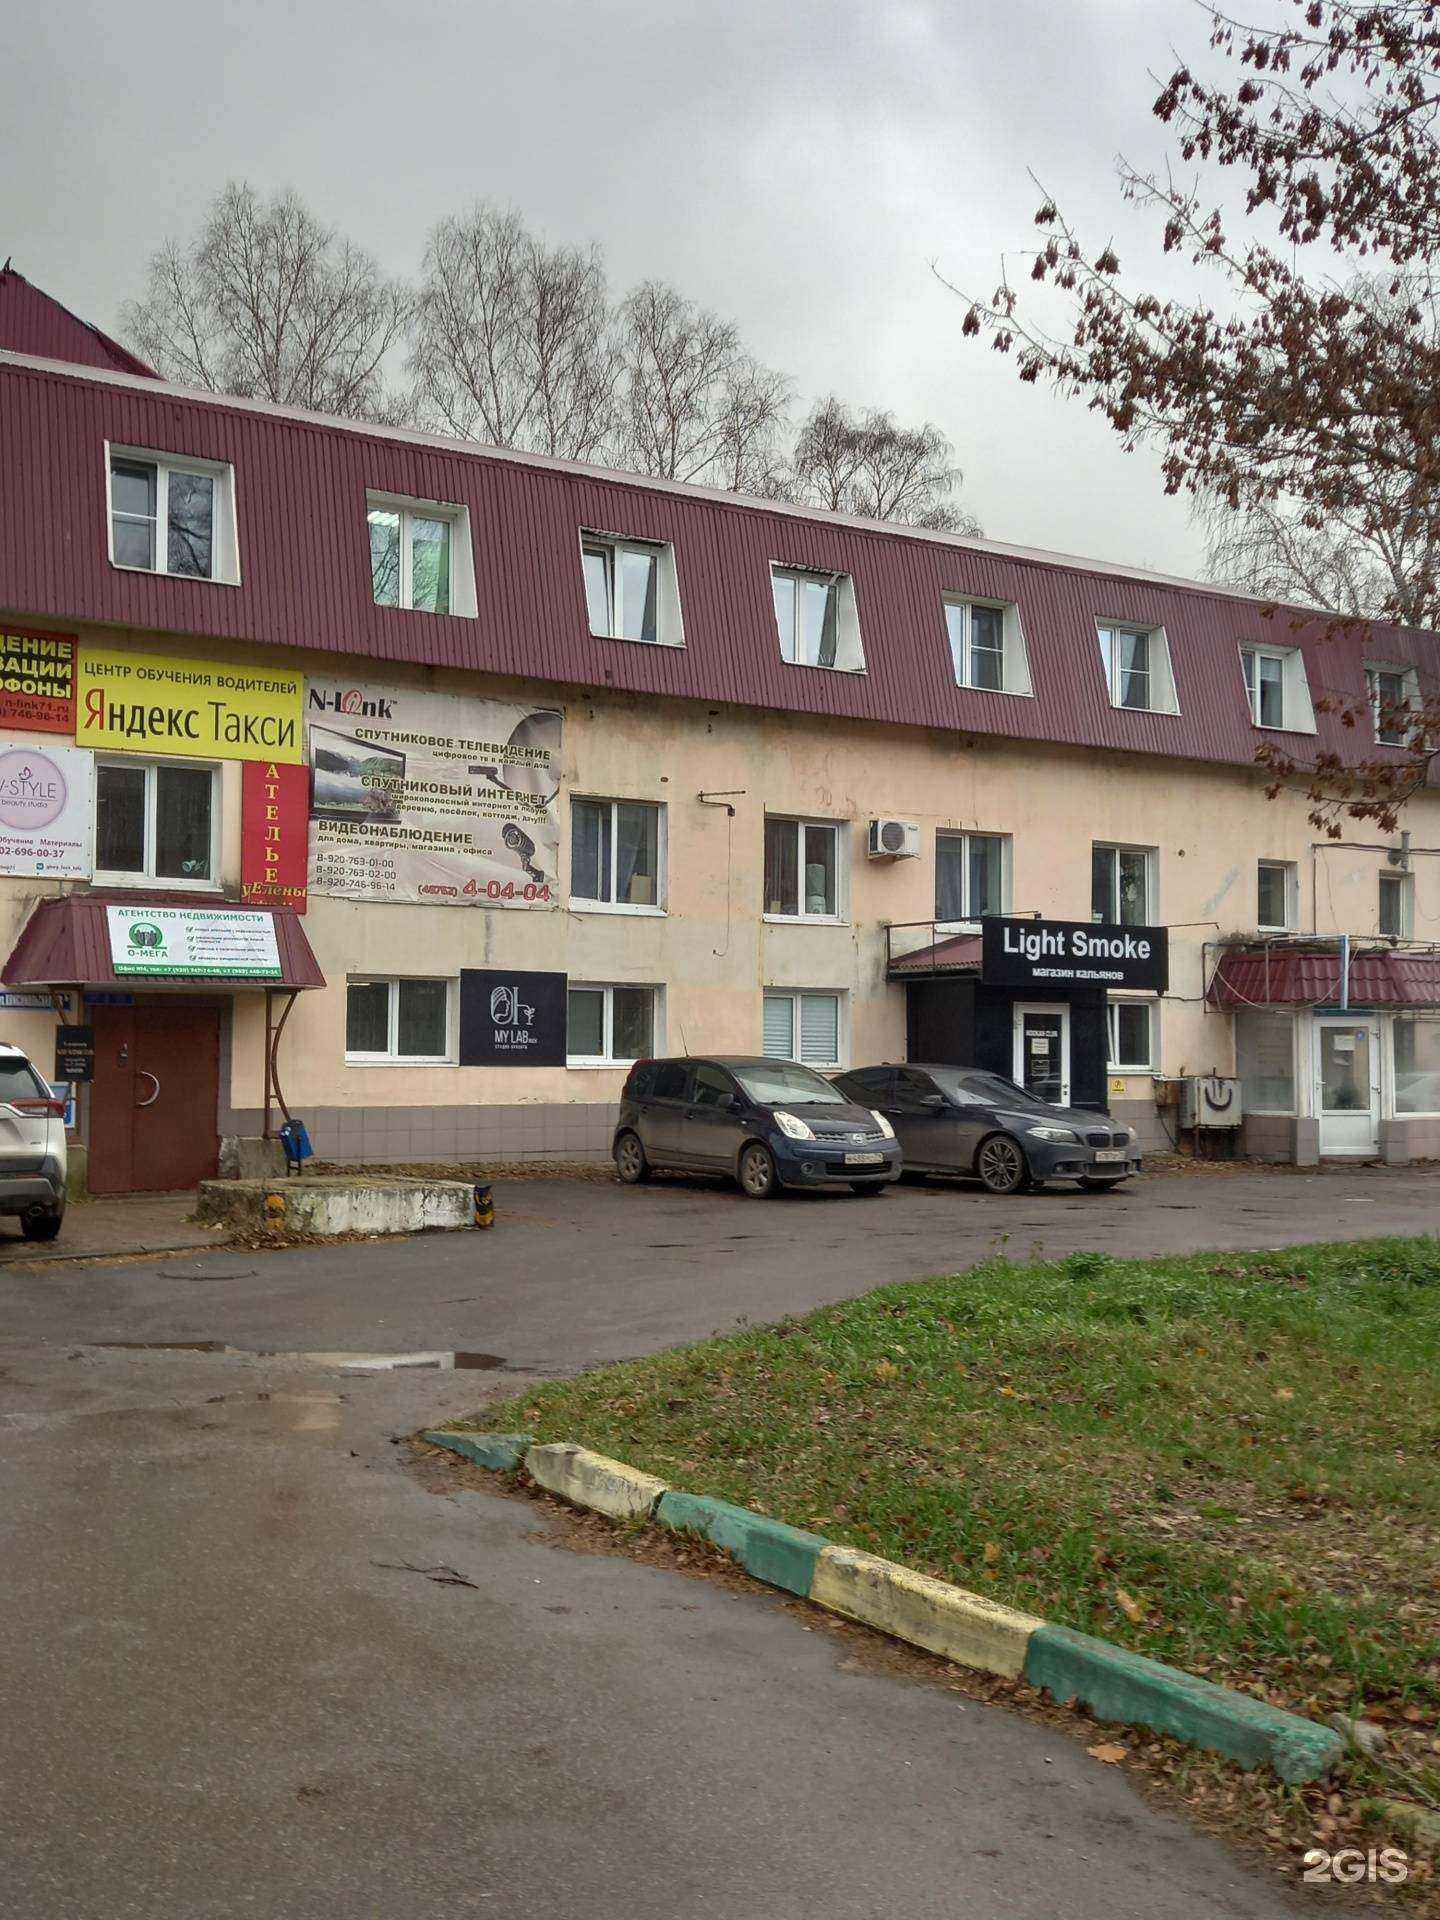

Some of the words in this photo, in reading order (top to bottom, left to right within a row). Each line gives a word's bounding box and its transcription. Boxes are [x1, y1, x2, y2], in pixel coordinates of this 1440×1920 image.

[0, 678, 72, 699] ФОНЫ
[84, 661, 132, 678] ЦЕНТР
[136, 667, 211, 686] ОБУЧЕНИЯ
[217, 676, 297, 695] ВОДИТЕЛЕЙ
[84, 688, 200, 739] Яндекс
[207, 701, 295, 748] Такси
[355, 728, 454, 749] СПУТНИКОВОЕ
[458, 739, 551, 760] ТЕЛЕВИДЕНИЕ
[361, 776, 472, 797] СПУТНИКОВЫЙ
[477, 788, 548, 805] ИНТЕРНЕТ
[264, 764, 281, 884] АТЕЛЬЕ
[318, 820, 473, 844] ВИДЕОНАБЛЮДЕНИЕ
[336, 837, 362, 846] дома,
[463, 848, 493, 856] офиса
[317, 853, 394, 868] 8-920-763-01-00
[316, 866, 397, 880] 8-920-763-02-00
[316, 877, 396, 890] 8-920-746-96-14
[463, 879, 551, 901] 4-04-04
[118, 909, 177, 919] АГЕНТСТВО
[179, 912, 264, 922] НЕДВИЖИМОСТИ
[127, 949, 169, 958] О-МЕГА
[1003, 926, 1066, 961] Light
[1072, 930, 1151, 959] Smoke
[1032, 967, 1075, 978] магазин
[1075, 969, 1124, 980] кальянов
[494, 1030, 509, 1044] MY
[510, 1030, 529, 1044] LAB
